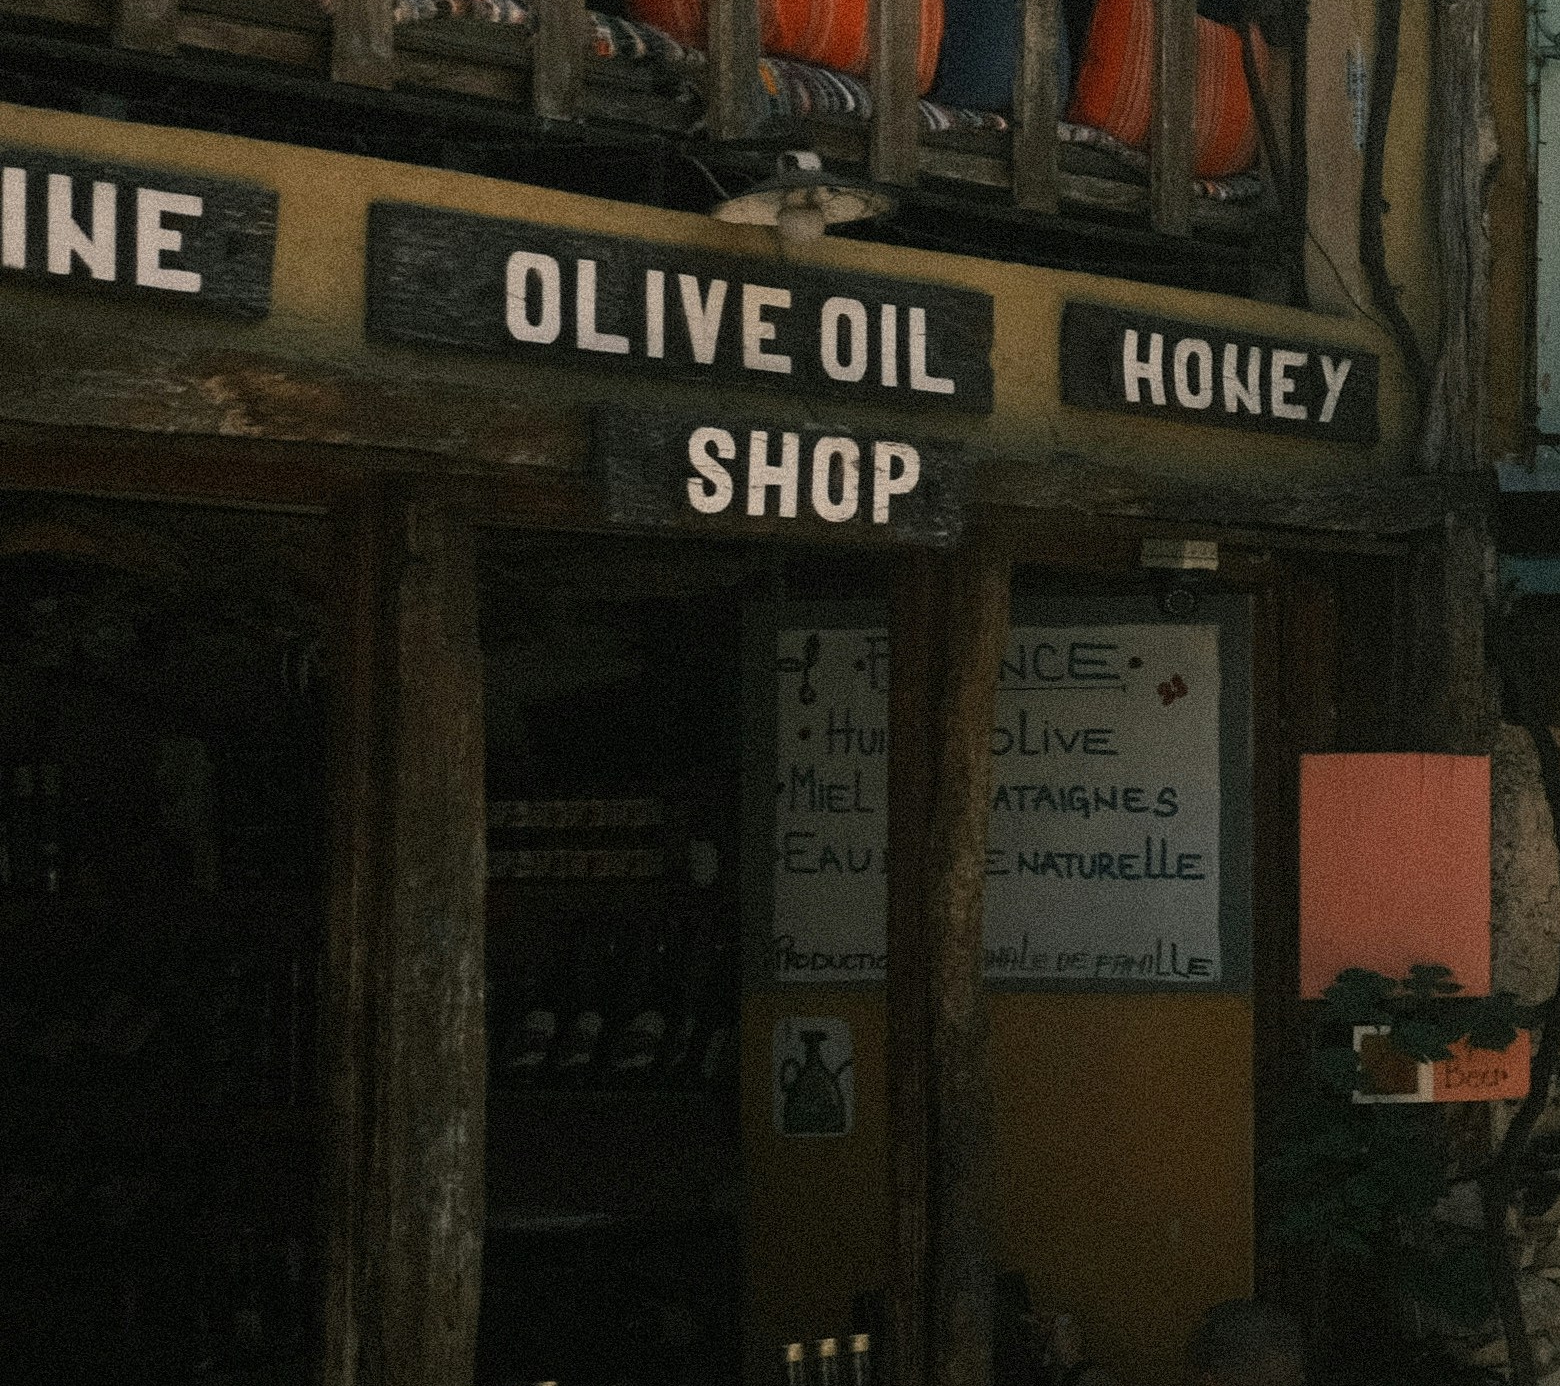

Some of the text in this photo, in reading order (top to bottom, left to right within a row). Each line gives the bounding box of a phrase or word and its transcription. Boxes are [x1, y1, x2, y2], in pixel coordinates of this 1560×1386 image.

[505, 249, 956, 395] OLIVE OIL
[1121, 328, 1352, 424] HONEY
[686, 425, 921, 525] SHOP
